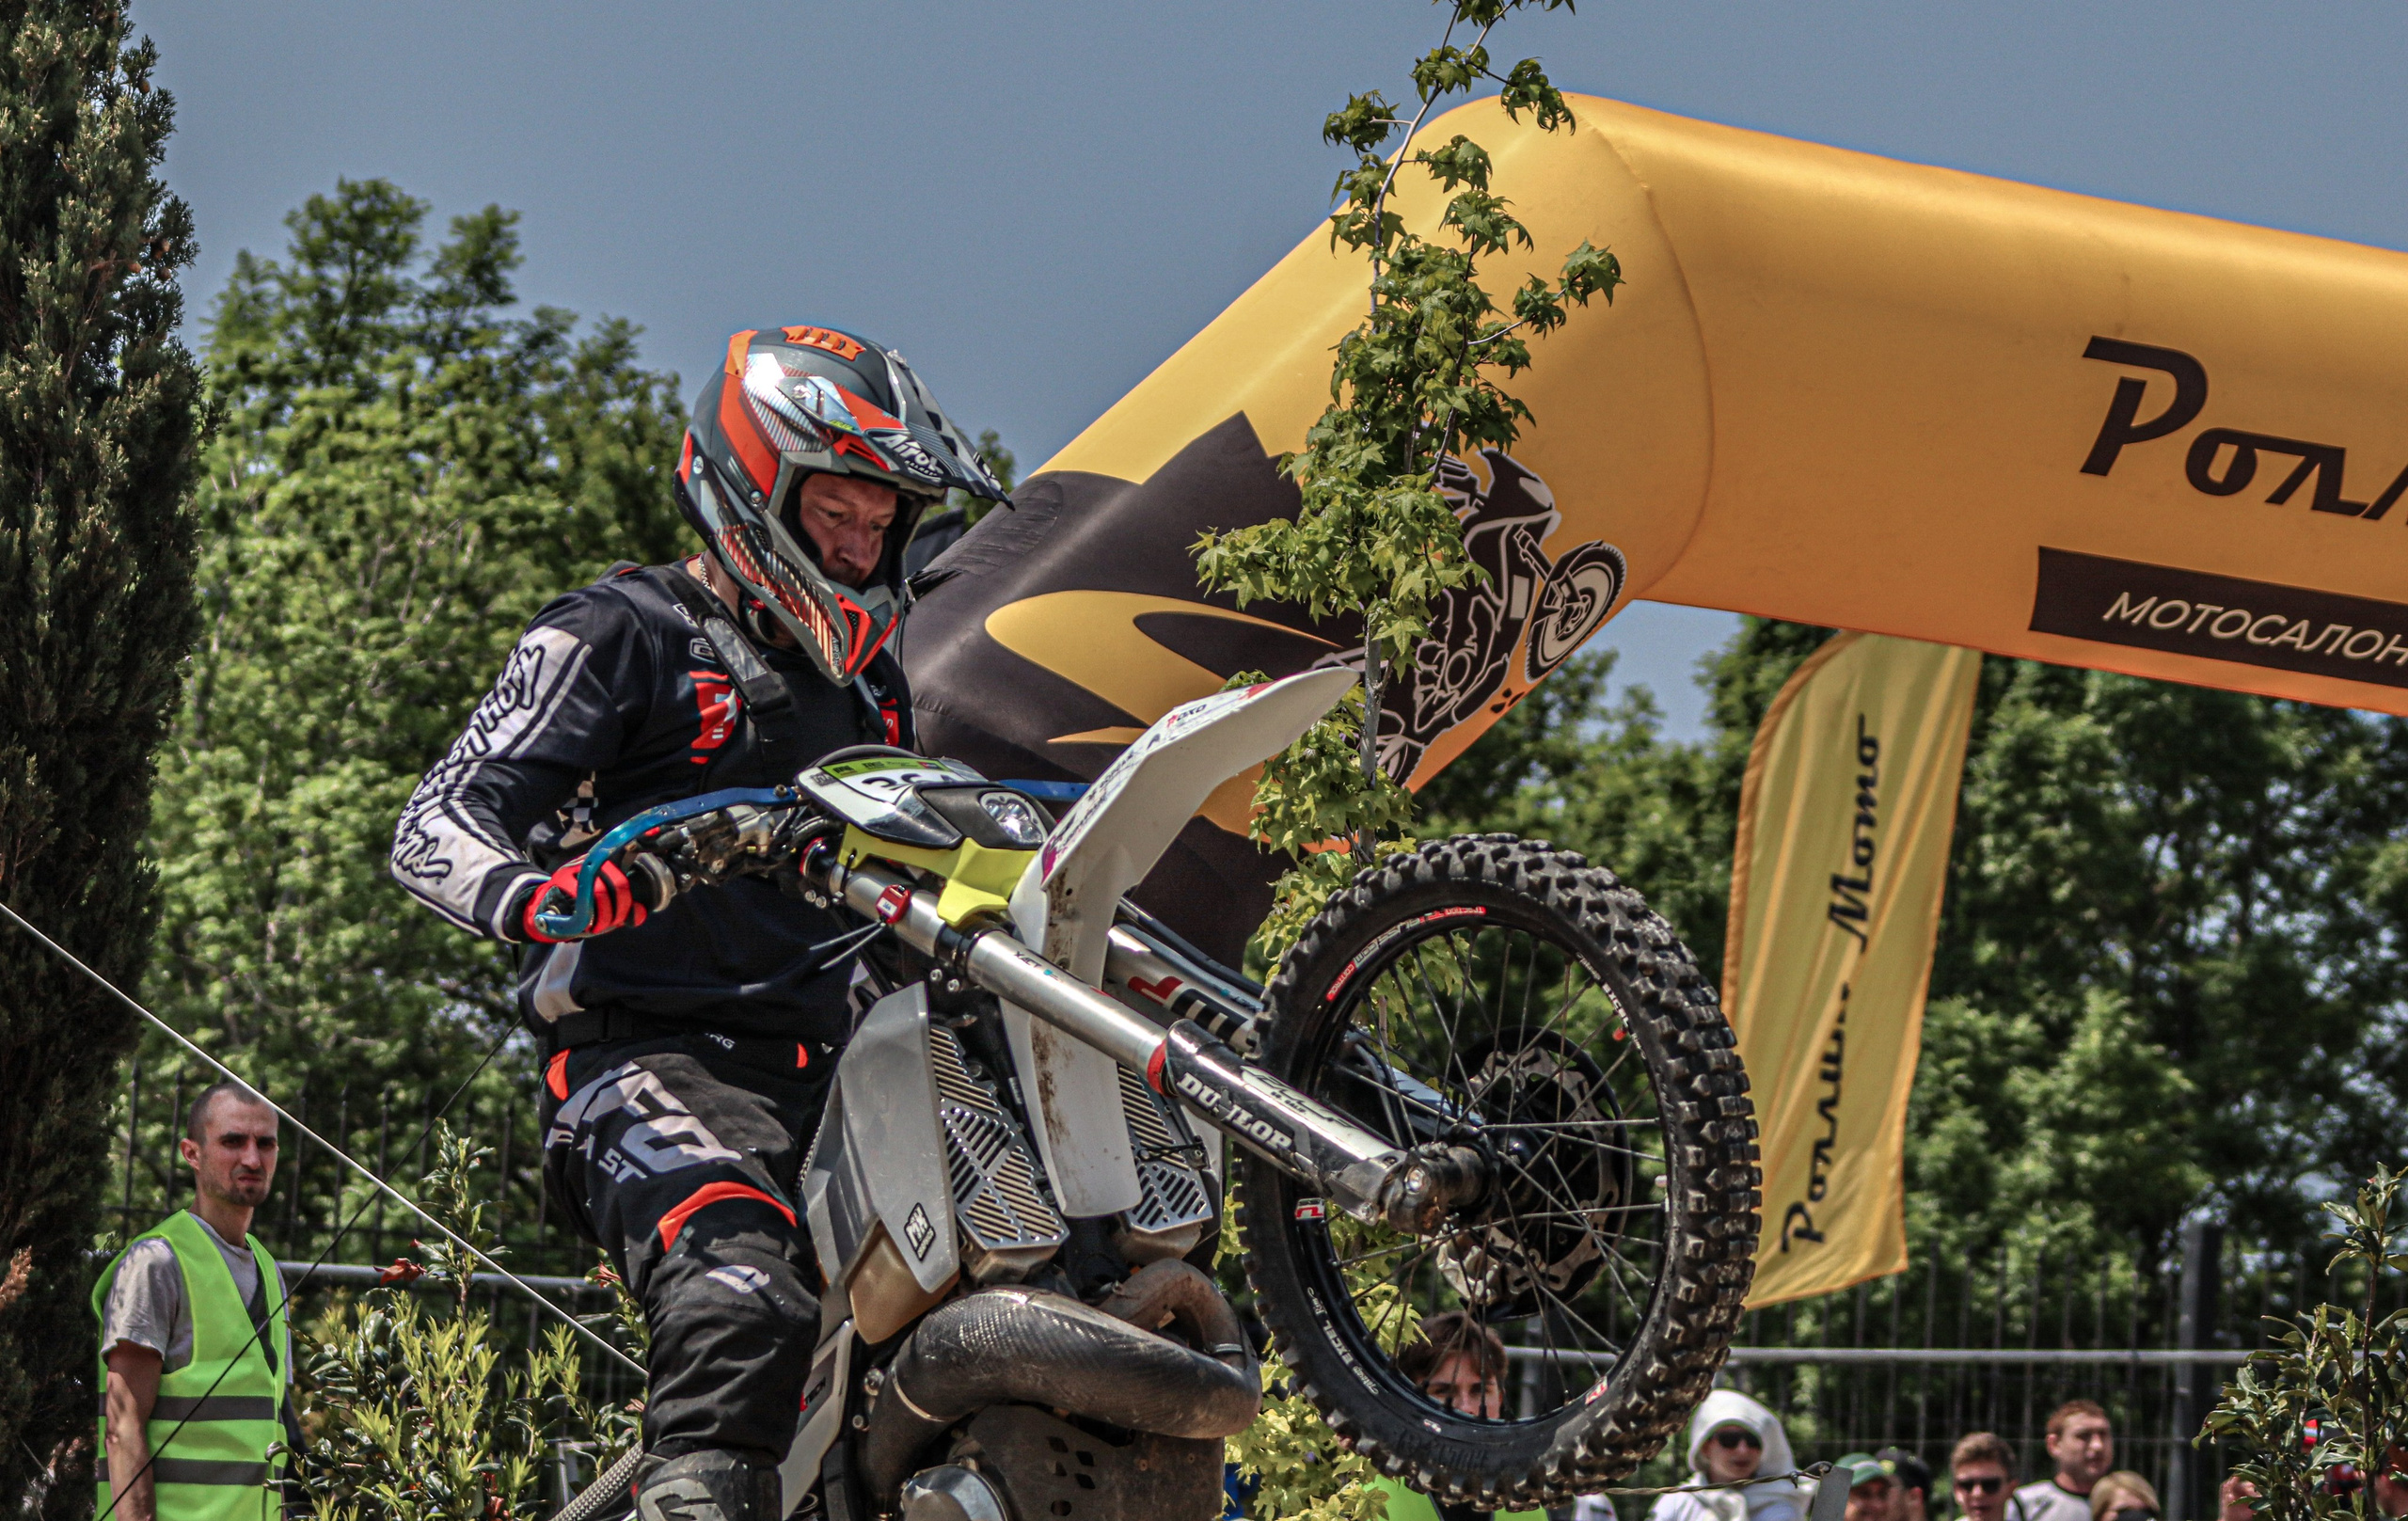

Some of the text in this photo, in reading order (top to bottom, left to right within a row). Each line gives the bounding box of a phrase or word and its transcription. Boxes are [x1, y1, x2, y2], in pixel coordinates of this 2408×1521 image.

[2101, 591, 2408, 667] МОТОСАЛОН
[1828, 713, 1880, 954] Мото
[1176, 1071, 1294, 1149] DULOP
[1323, 1319, 1354, 1365] EXCEL
